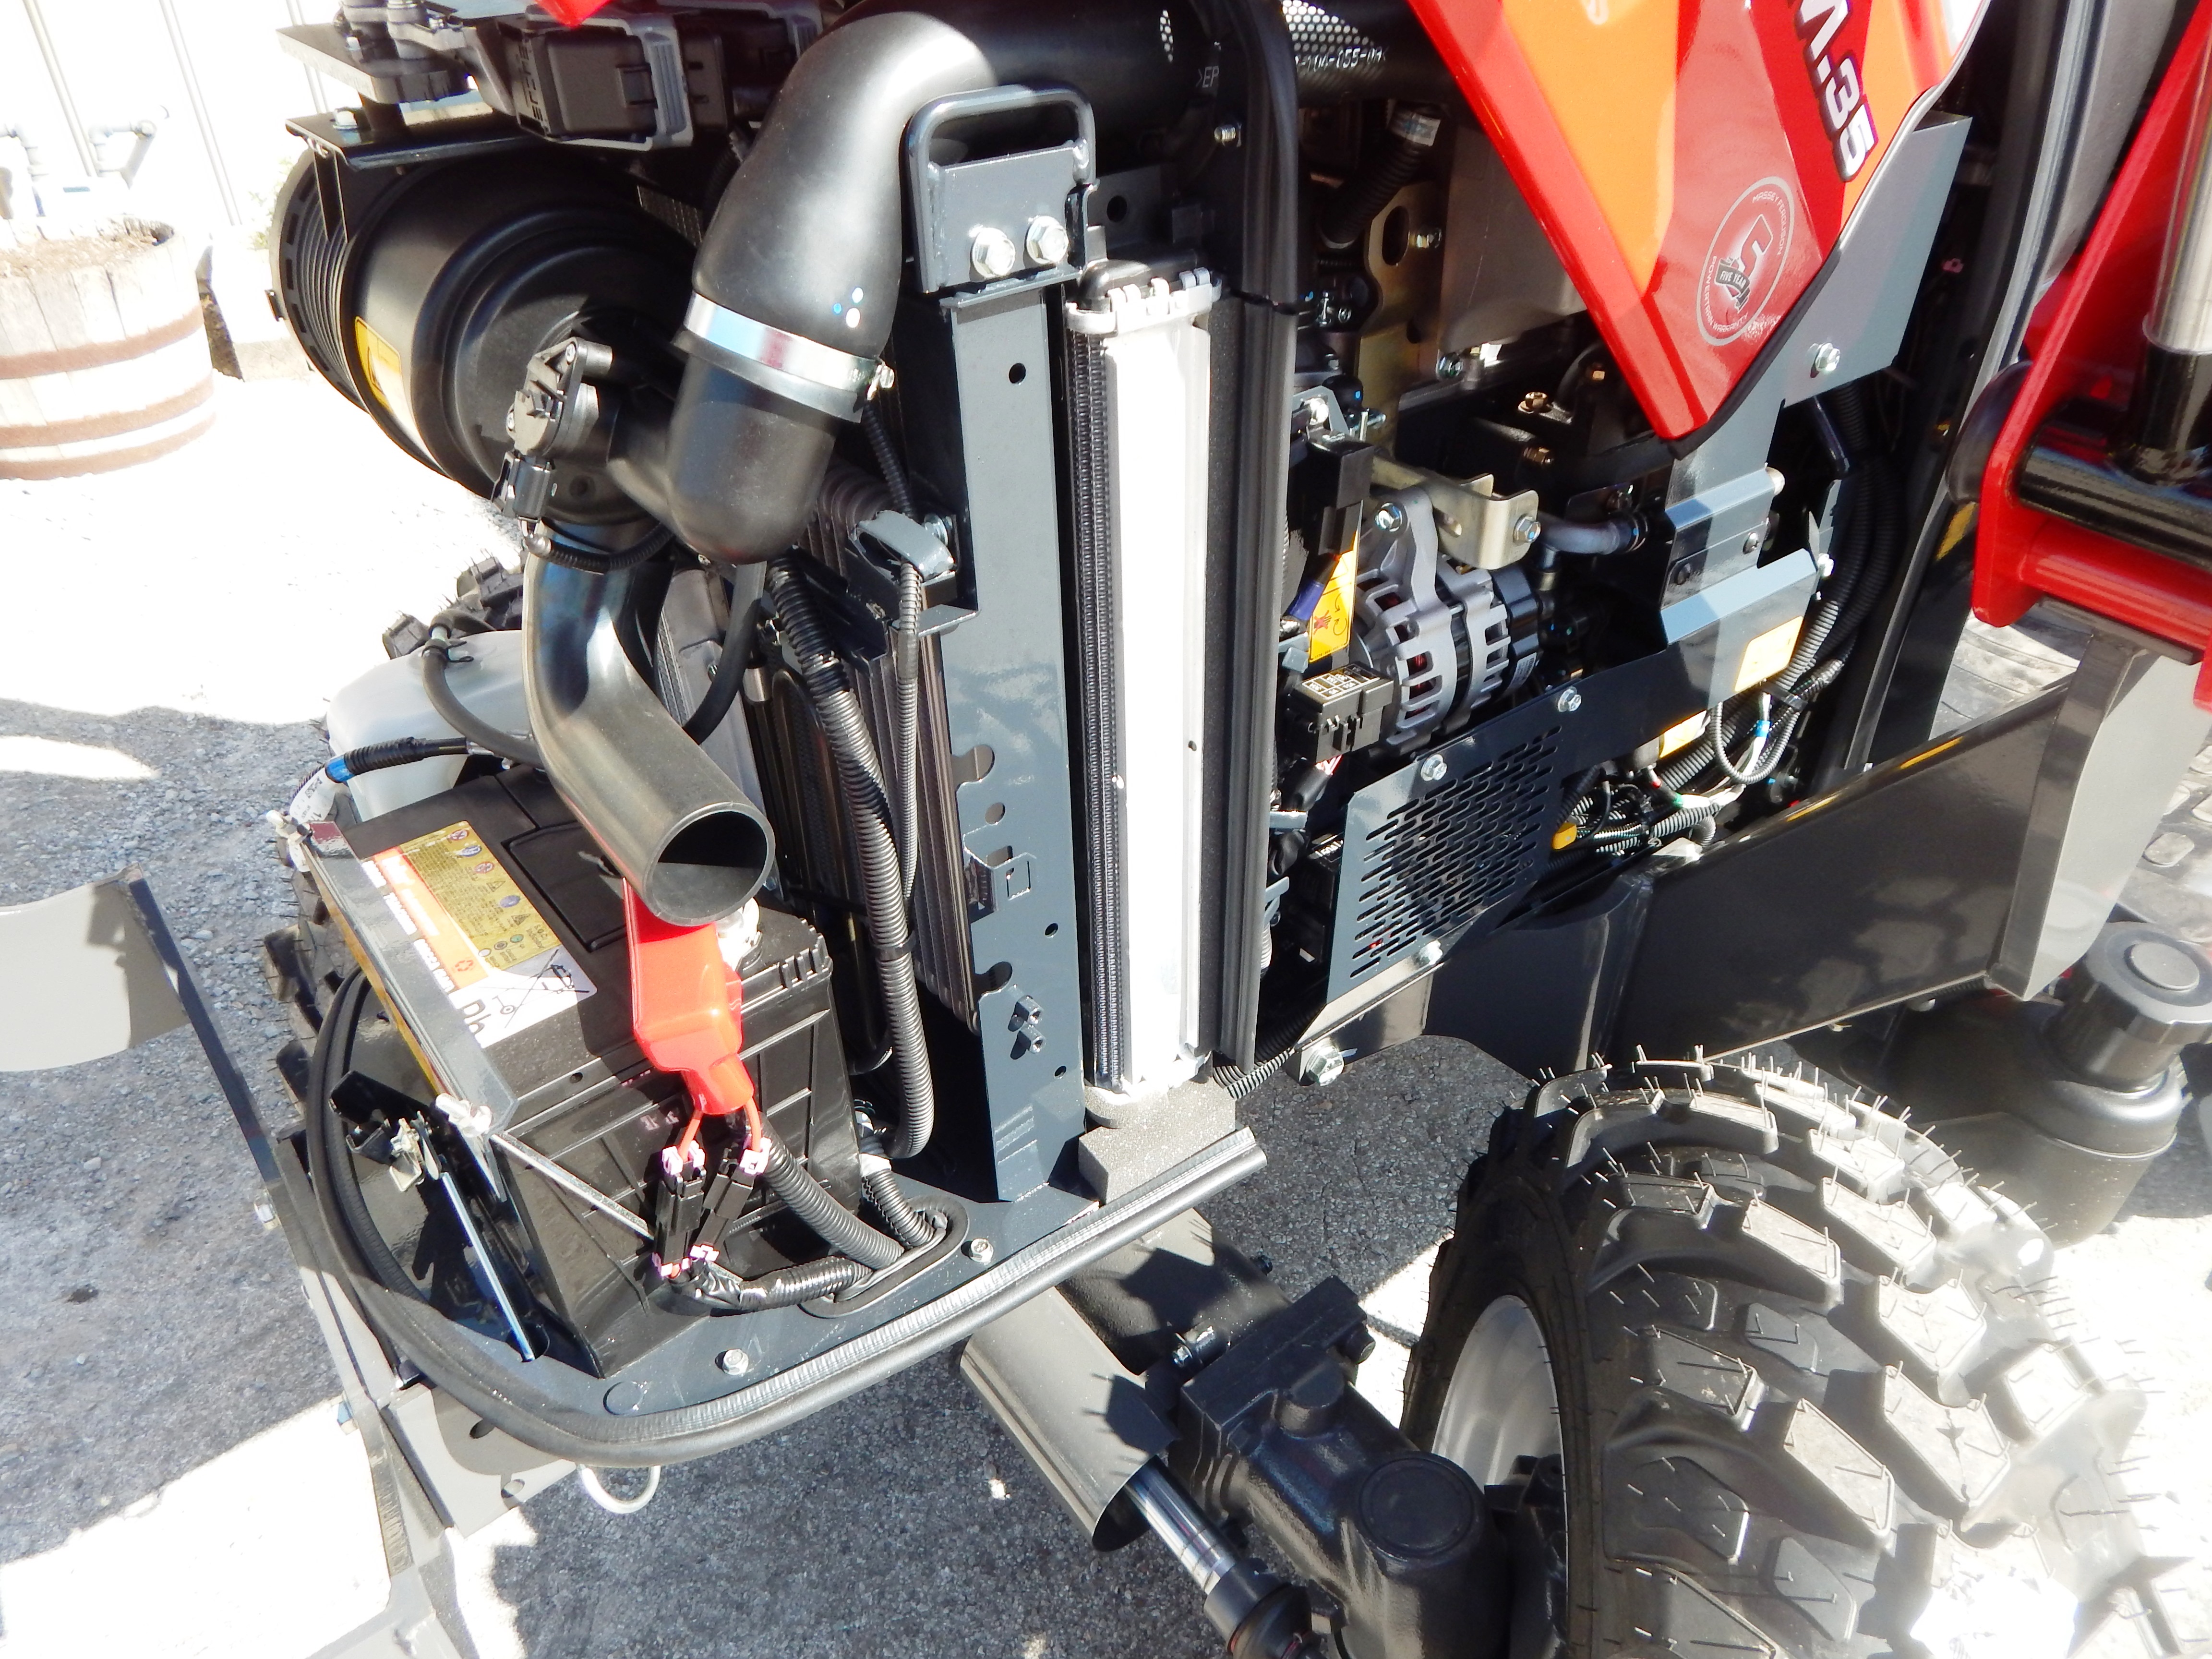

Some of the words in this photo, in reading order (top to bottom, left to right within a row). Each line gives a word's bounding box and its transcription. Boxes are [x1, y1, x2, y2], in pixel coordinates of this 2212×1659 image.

[1752, 191, 1779, 203] MASSEY
[1777, 199, 1787, 255] FERGUSON
[1705, 256, 1717, 326] POWERTRAIN
[1712, 312, 1748, 332] WARRANTY
[1720, 270, 1732, 282] FIVE
[1733, 273, 1747, 289] YEAR
